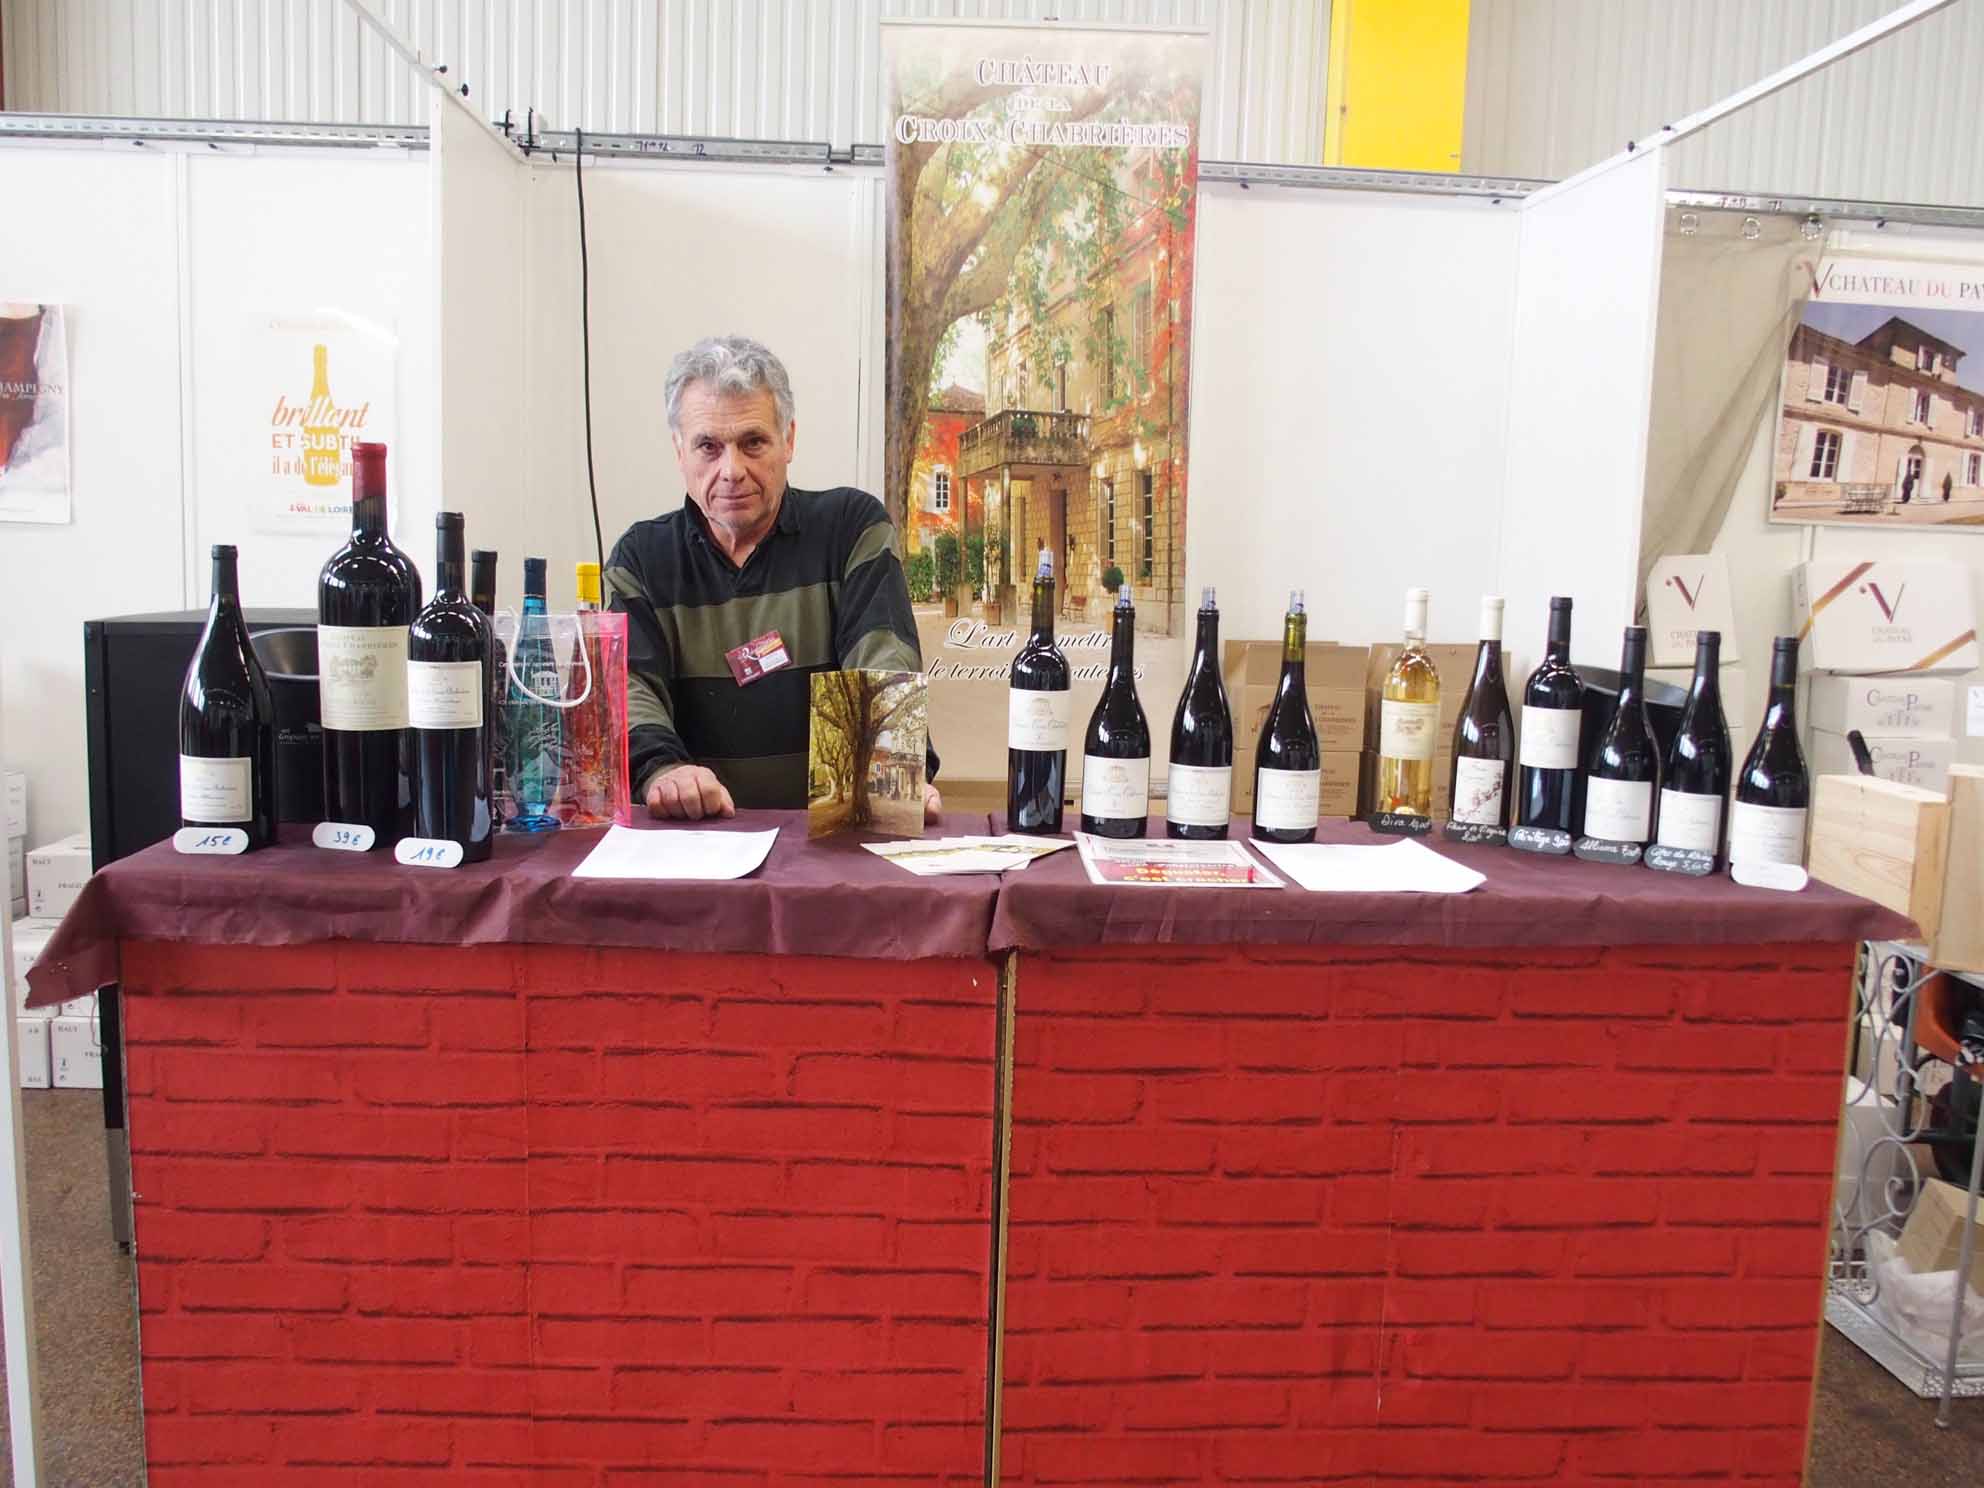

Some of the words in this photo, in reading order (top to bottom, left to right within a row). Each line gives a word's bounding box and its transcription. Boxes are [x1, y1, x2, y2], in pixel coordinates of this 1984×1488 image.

[977, 55, 1111, 87] CHÂTEAU
[896, 115, 988, 144] CROIX
[1008, 115, 1190, 146] CHABRIÈRES
[1828, 274, 1920, 297] CHATEAU
[1926, 281, 1951, 298] DU
[271, 396, 369, 428] brillant
[272, 433, 294, 448] ET
[283, 461, 291, 475] a
[945, 617, 1014, 648] L'art
[1057, 630, 1113, 648] mettr
[929, 659, 947, 680] le
